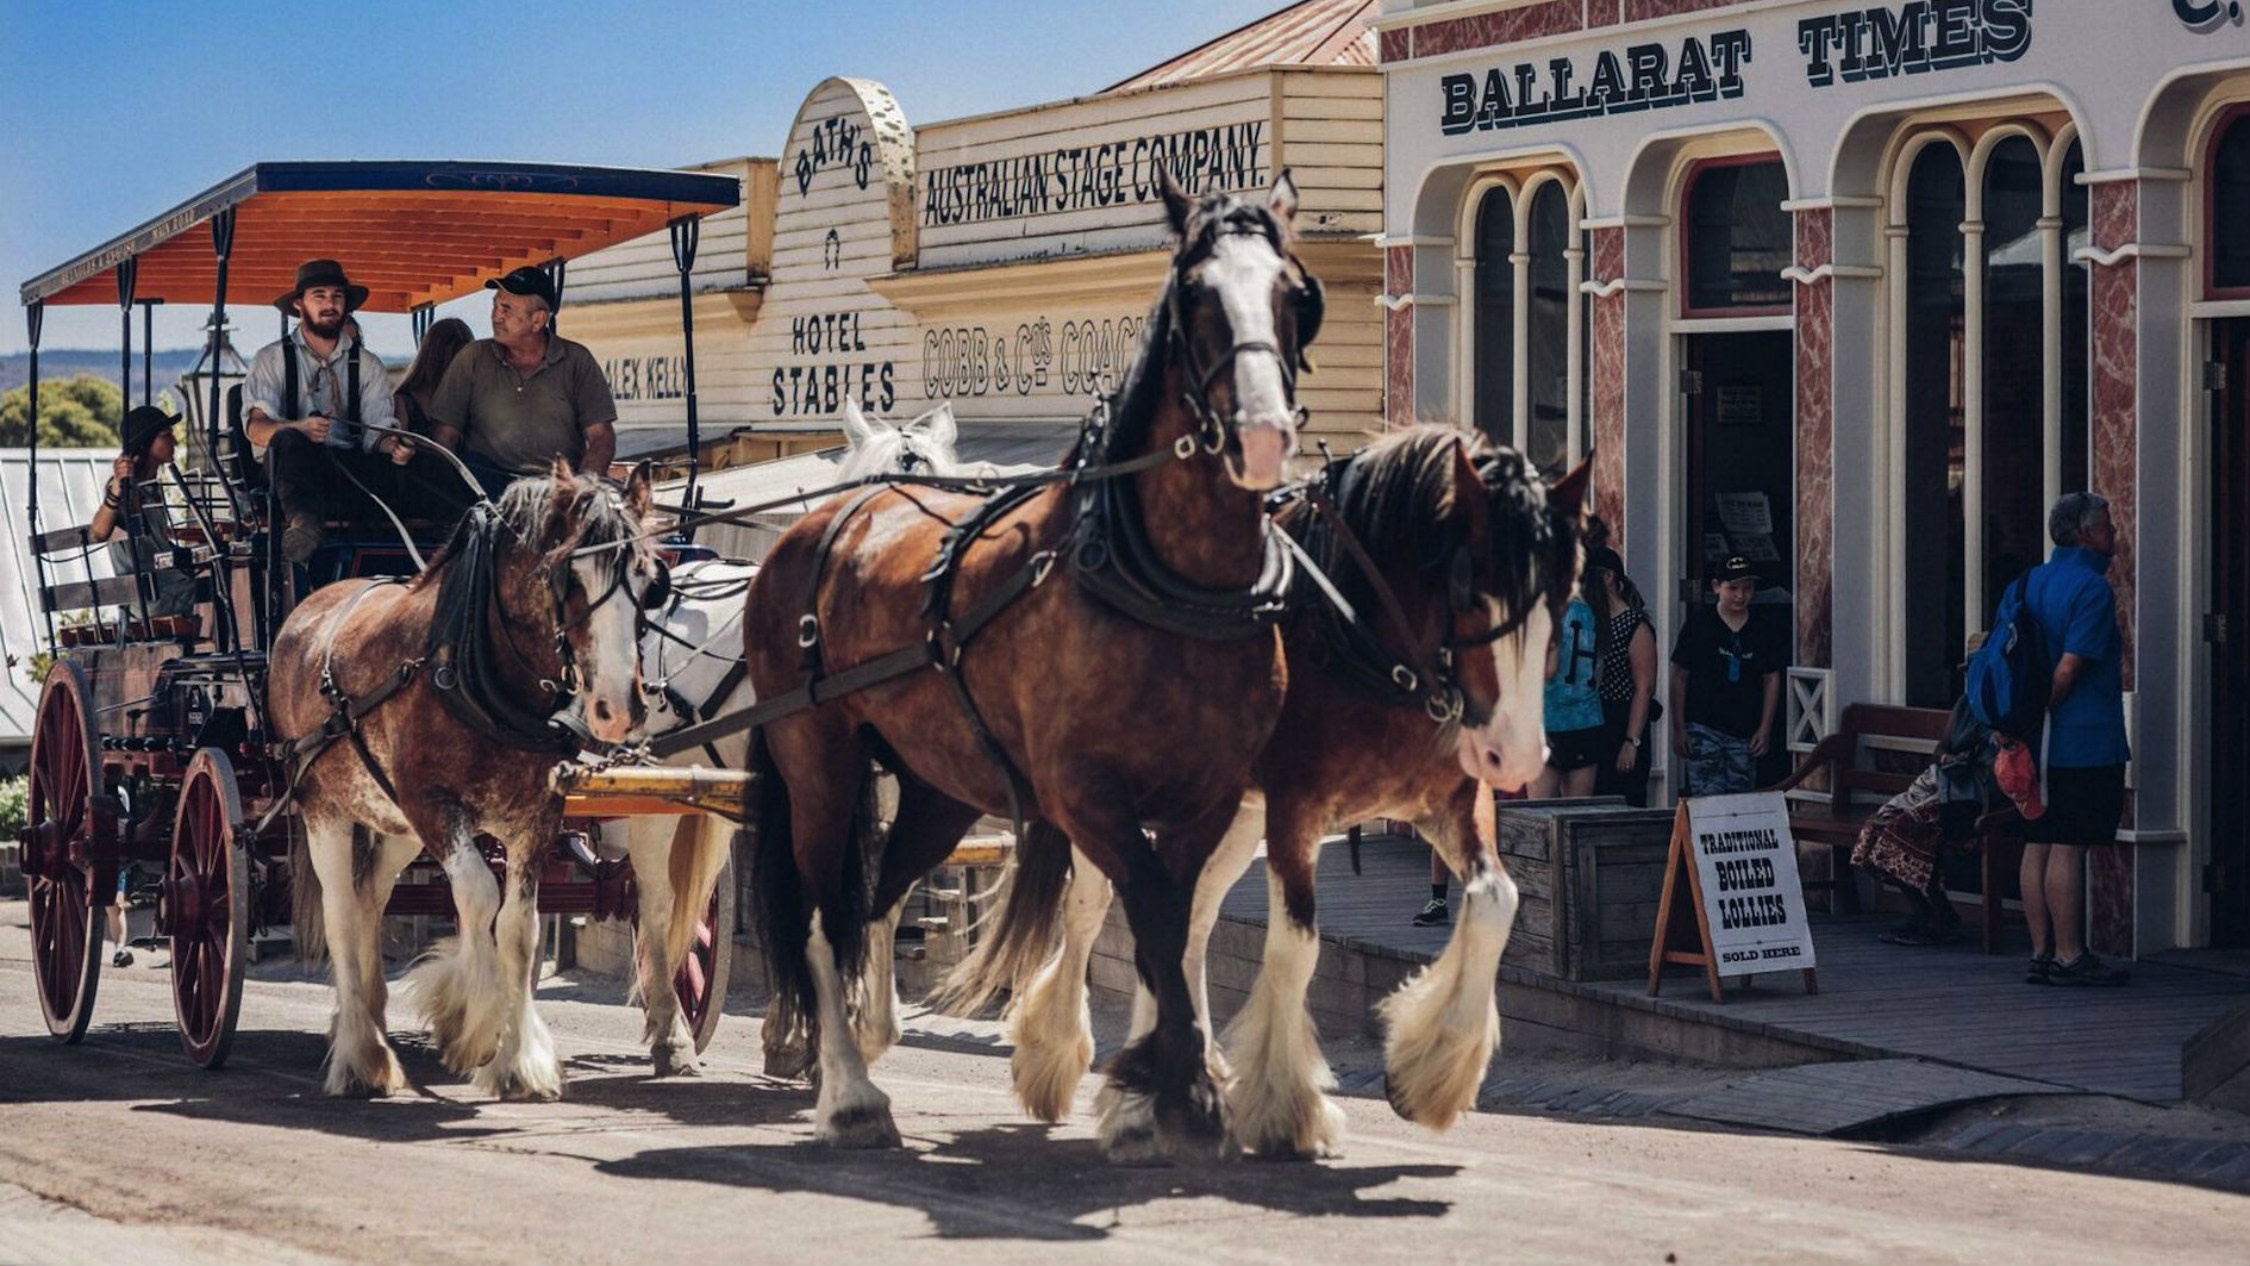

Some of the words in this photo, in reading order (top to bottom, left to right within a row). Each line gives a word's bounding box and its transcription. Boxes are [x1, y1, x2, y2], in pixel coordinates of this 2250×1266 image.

[1441, 29, 1751, 136] BALLARAT
[1798, 0, 2033, 88] TIMES
[795, 117, 872, 198] BATH'S
[925, 153, 1049, 226] AUSTRALIAN
[1055, 141, 1127, 211] STAGE
[793, 312, 866, 355] HOTEL
[605, 358, 641, 400] ALEX
[924, 326, 989, 399] COBB
[994, 337, 1010, 391] &
[1061, 316, 1143, 396] COAC
[772, 361, 895, 416] STABLES
[1700, 828, 1779, 855] TRADITIONAL
[1715, 857, 1775, 892] BOILED
[1718, 894, 1787, 930] LOLLIES
[1722, 950, 1758, 963] SOLD
[1762, 946, 1801, 960] HERE
